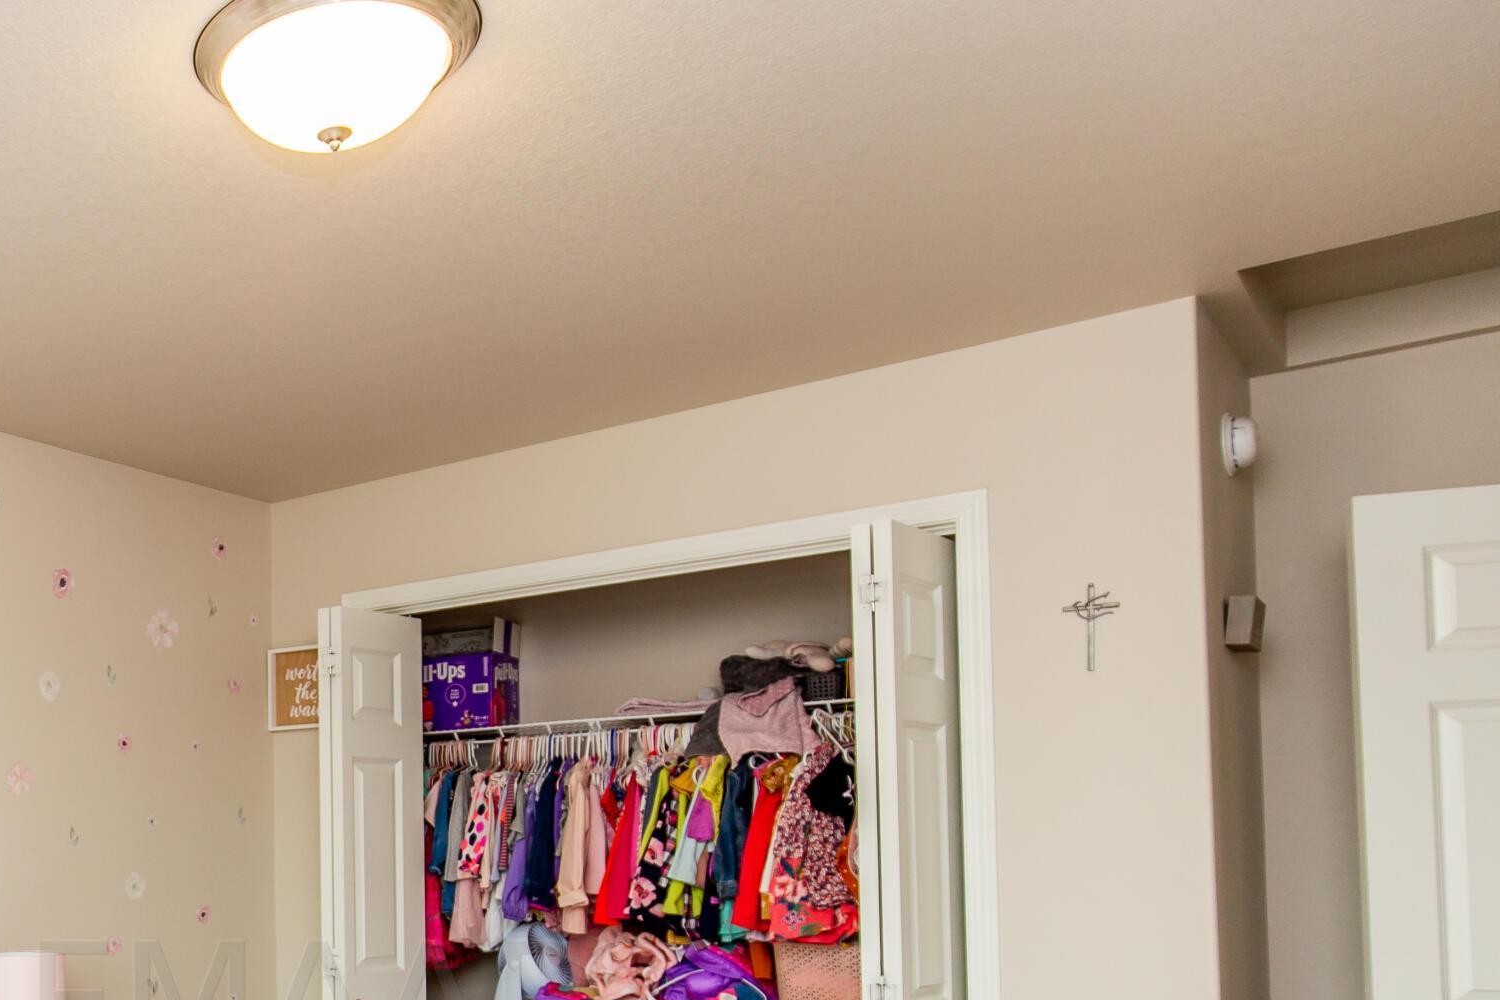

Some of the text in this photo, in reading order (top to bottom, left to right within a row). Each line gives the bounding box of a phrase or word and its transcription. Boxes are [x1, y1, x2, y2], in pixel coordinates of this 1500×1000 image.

[286, 661, 319, 681] wort
[423, 661, 466, 683] ll-Ups
[295, 682, 318, 704] the
[289, 700, 319, 718] wai
